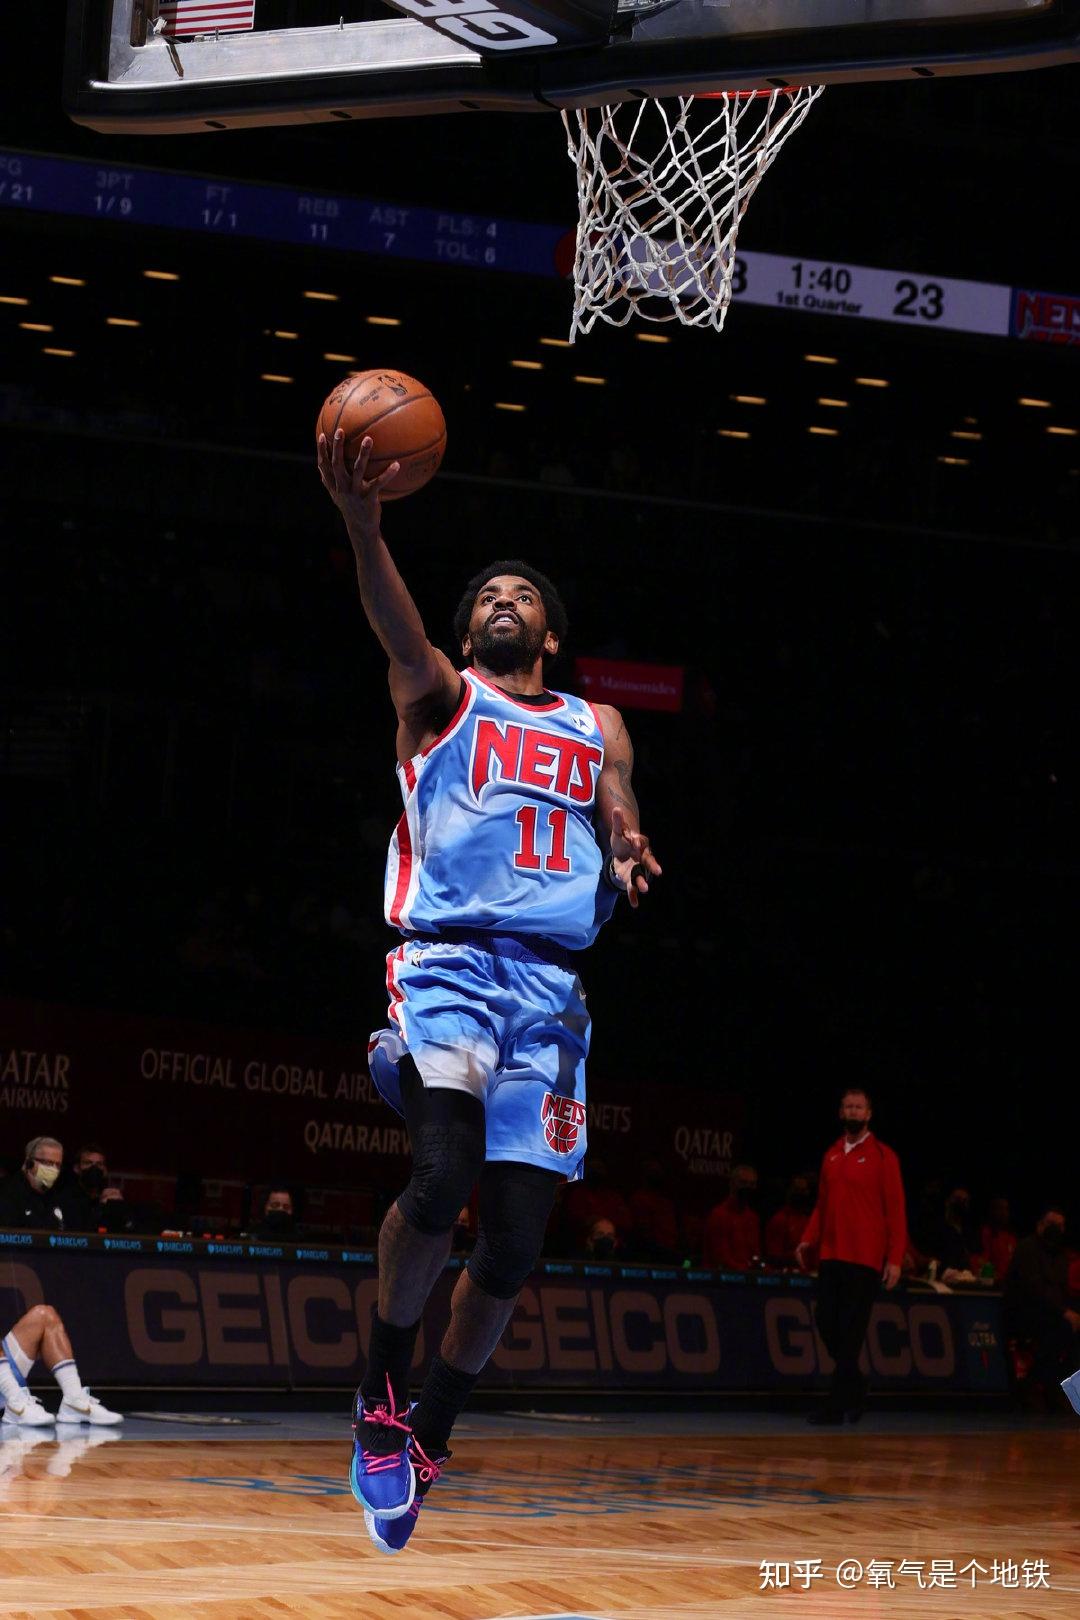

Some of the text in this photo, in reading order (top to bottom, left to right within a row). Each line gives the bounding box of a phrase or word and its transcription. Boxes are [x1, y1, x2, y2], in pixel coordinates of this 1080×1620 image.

[96, 170, 134, 191] 3PT
[205, 184, 231, 204] FT
[297, 197, 340, 217] REB
[368, 205, 410, 227] AST
[310, 222, 328, 241] 11
[383, 231, 396, 249] 7
[486, 221, 498, 238] 4
[484, 245, 497, 264] 6
[792, 262, 851, 294] 1:40
[776, 290, 861, 314] 1st Quarter
[893, 279, 944, 319] 23
[468, 714, 605, 810] NETS
[513, 804, 571, 873] 11
[0, 1048, 72, 1090] ATAR
[139, 1047, 384, 1103] OFFICIAL GLOBAL AIRL
[541, 1092, 587, 1126] NETS
[303, 1120, 414, 1156] QATARAIRW
[673, 1124, 735, 1160] QATAR
[56, 1236, 89, 1248] BARCLAYS
[491, 1285, 722, 1375] GEICO
[763, 1296, 955, 1378] GCO
